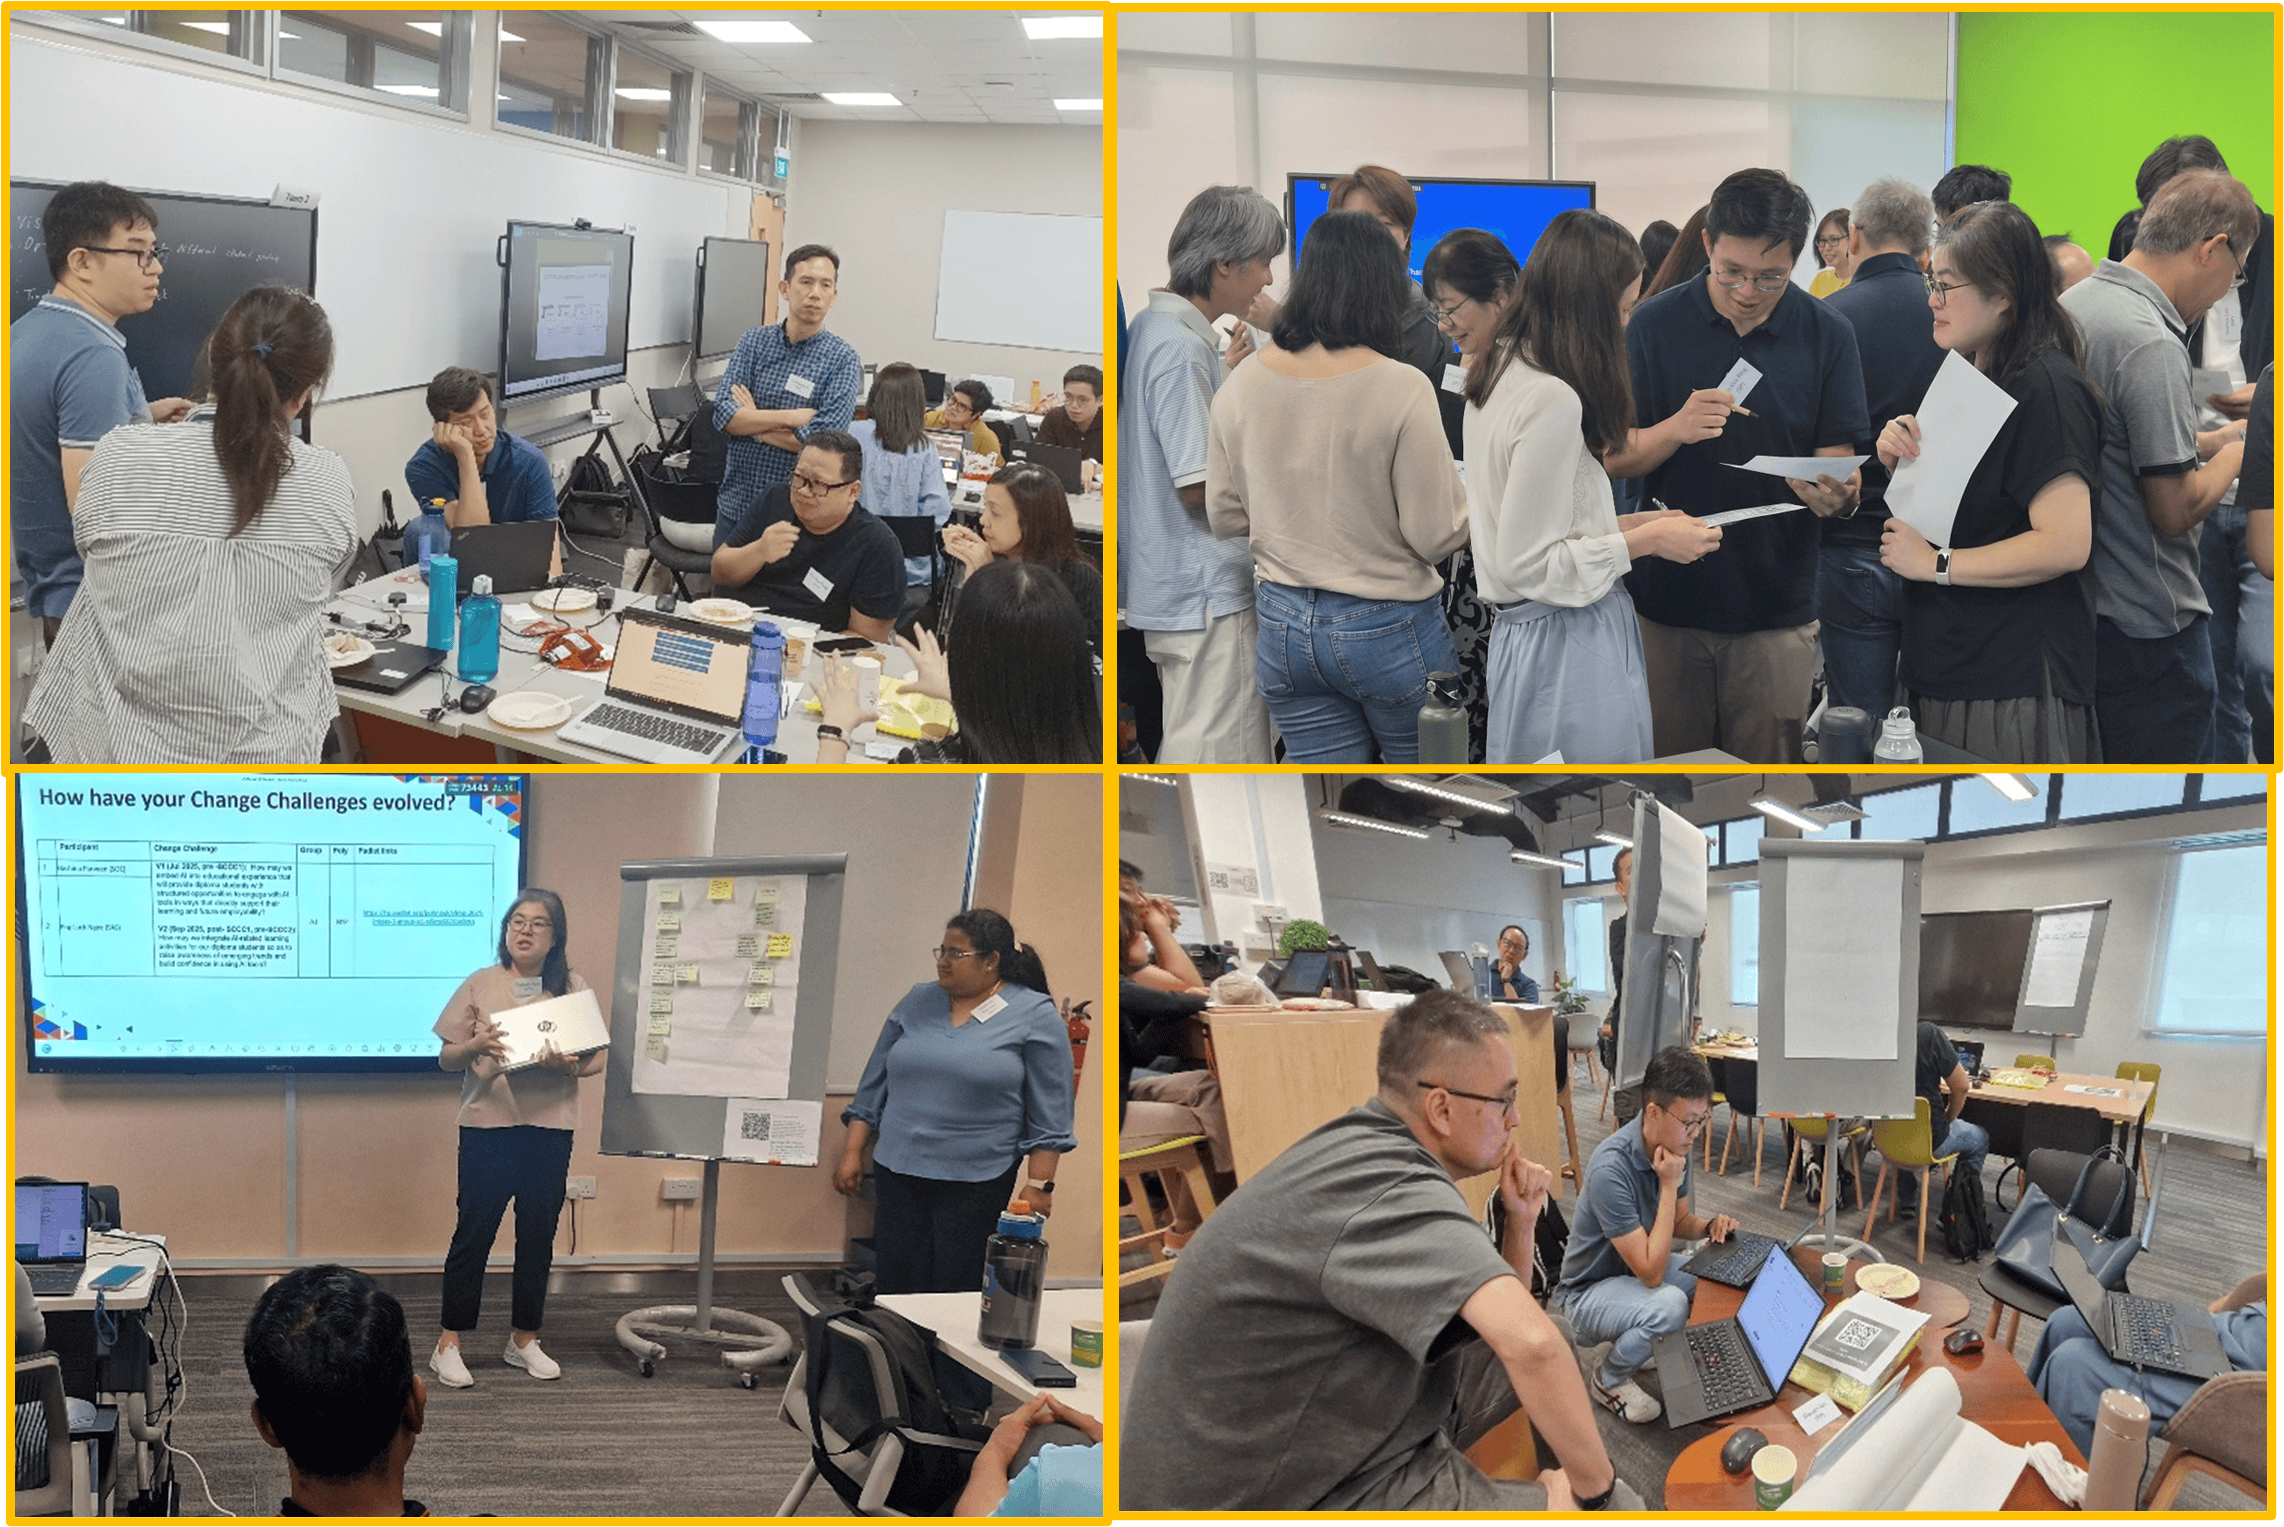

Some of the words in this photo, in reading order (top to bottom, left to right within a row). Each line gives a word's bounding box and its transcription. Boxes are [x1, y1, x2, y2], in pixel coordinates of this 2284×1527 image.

[39, 788, 84, 806] How
[90, 788, 136, 806] have
[141, 793, 185, 811] your
[191, 791, 261, 812] Change
[267, 792, 367, 814] Challenges
[373, 793, 456, 811] evolved?
[154, 844, 181, 852] Change
[333, 847, 348, 855] Poly
